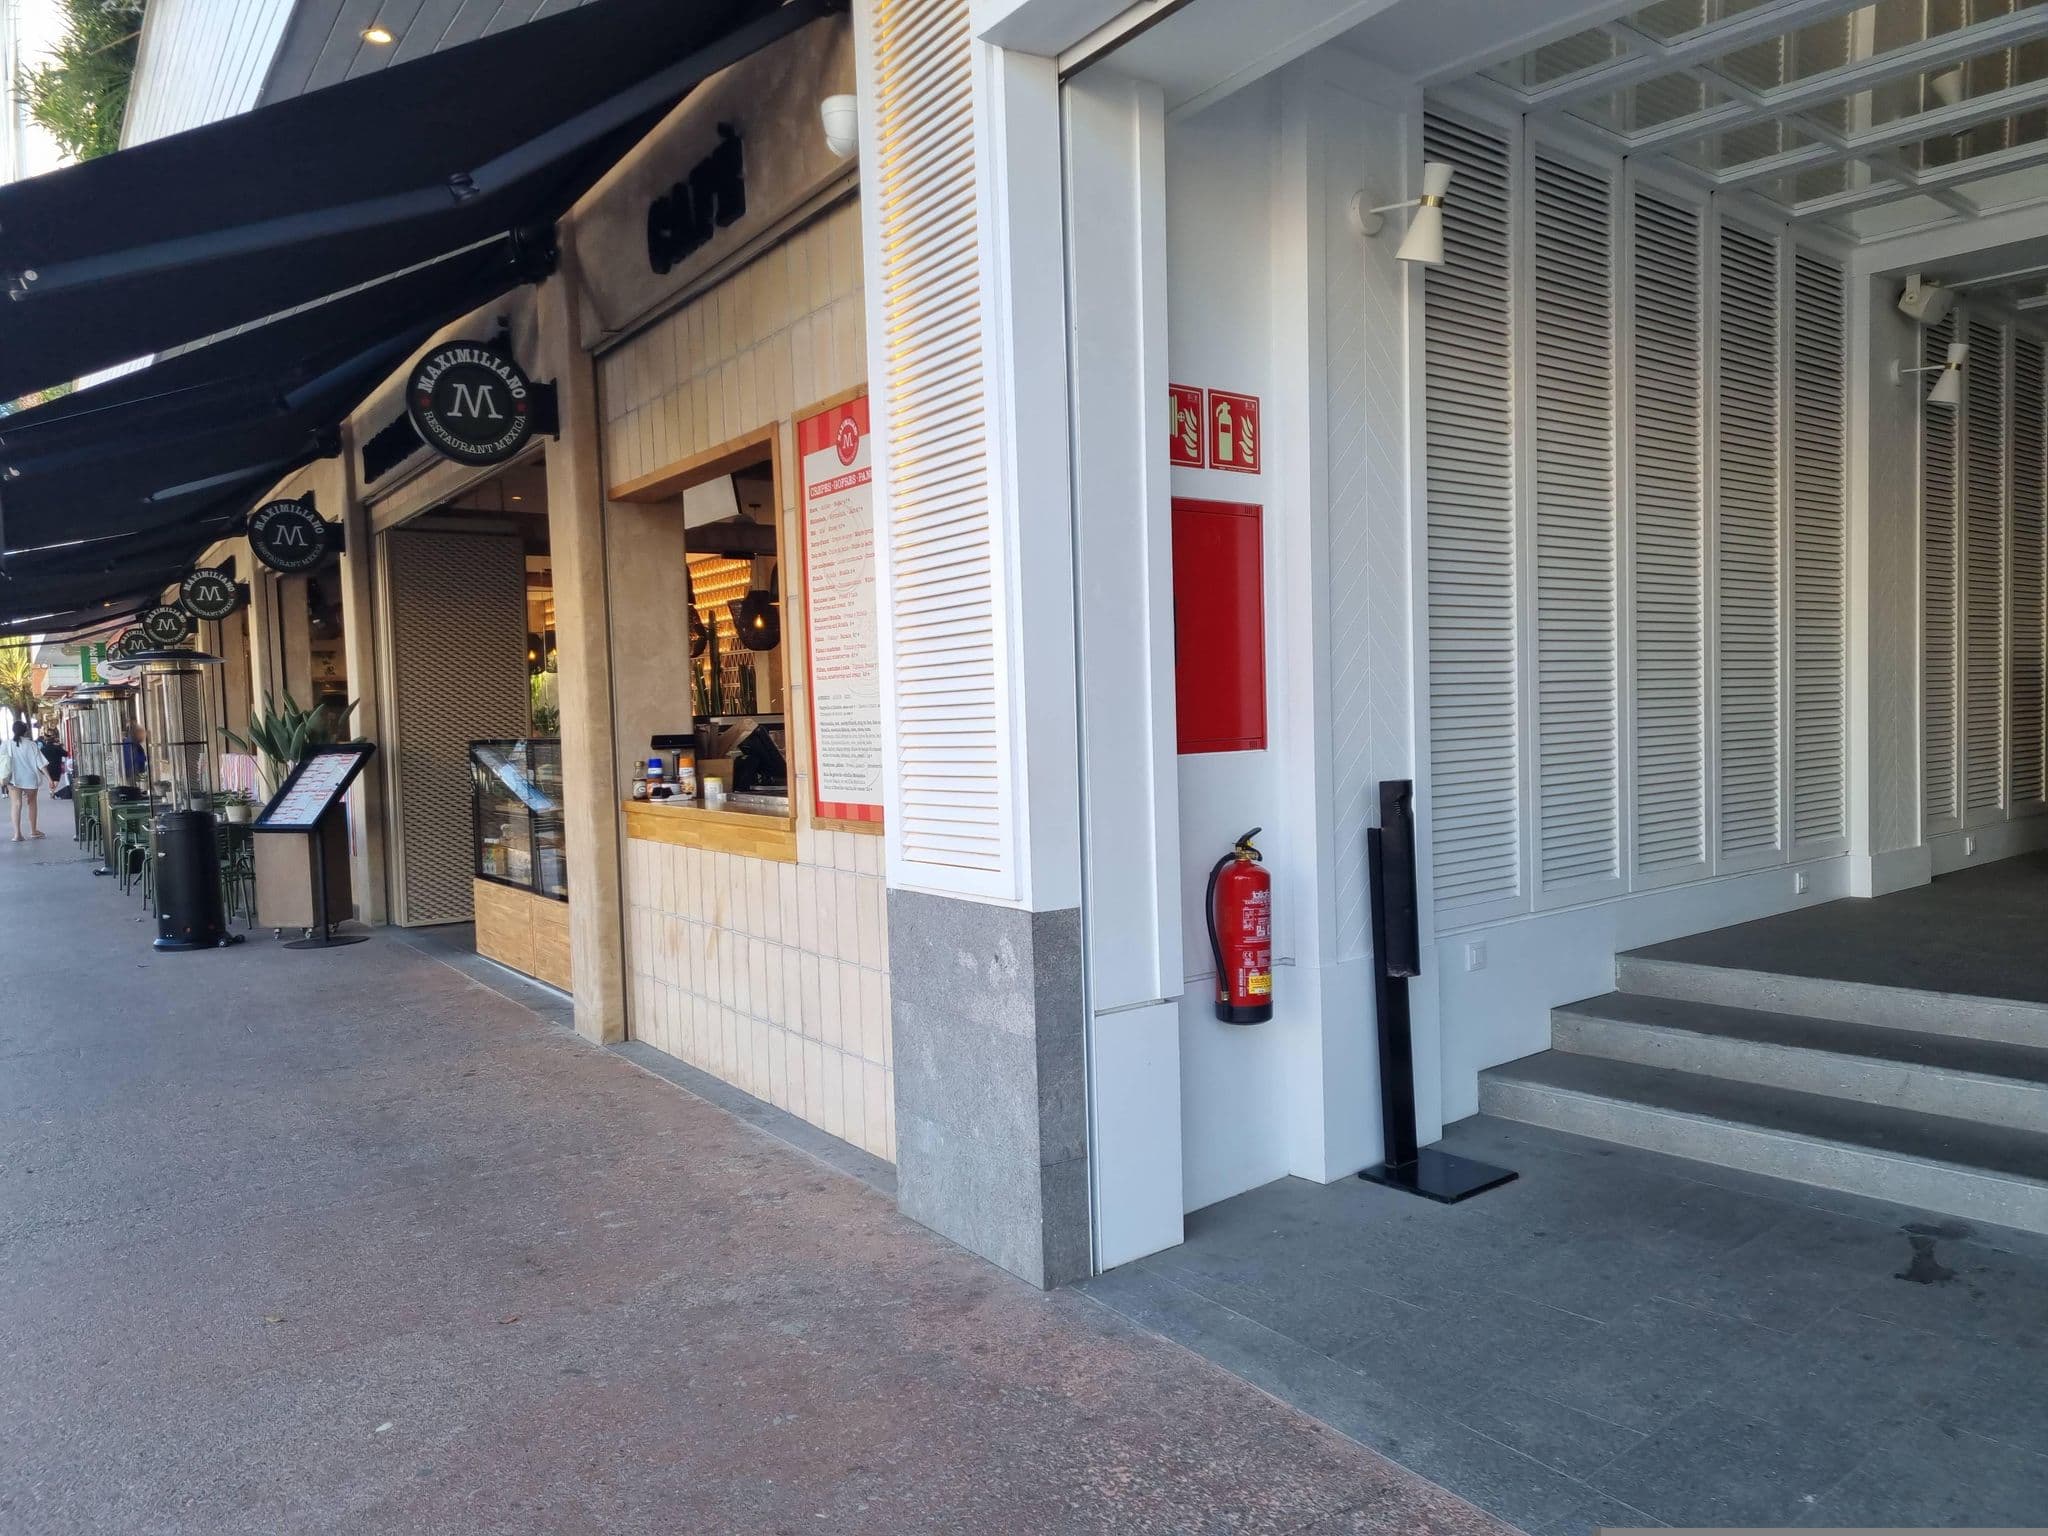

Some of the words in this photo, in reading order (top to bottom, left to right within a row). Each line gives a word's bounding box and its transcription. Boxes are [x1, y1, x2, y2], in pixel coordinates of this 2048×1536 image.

[417, 348, 526, 399] MAXIMILIANO
[446, 383, 503, 419] M
[423, 411, 493, 454] RESTAURANT
[254, 503, 325, 534] MAXIMILIANO
[272, 524, 309, 546] M
[183, 570, 235, 592] MAXIMILIANO
[196, 585, 223, 601] M
[156, 618, 178, 631] M
[129, 639, 147, 650] M
